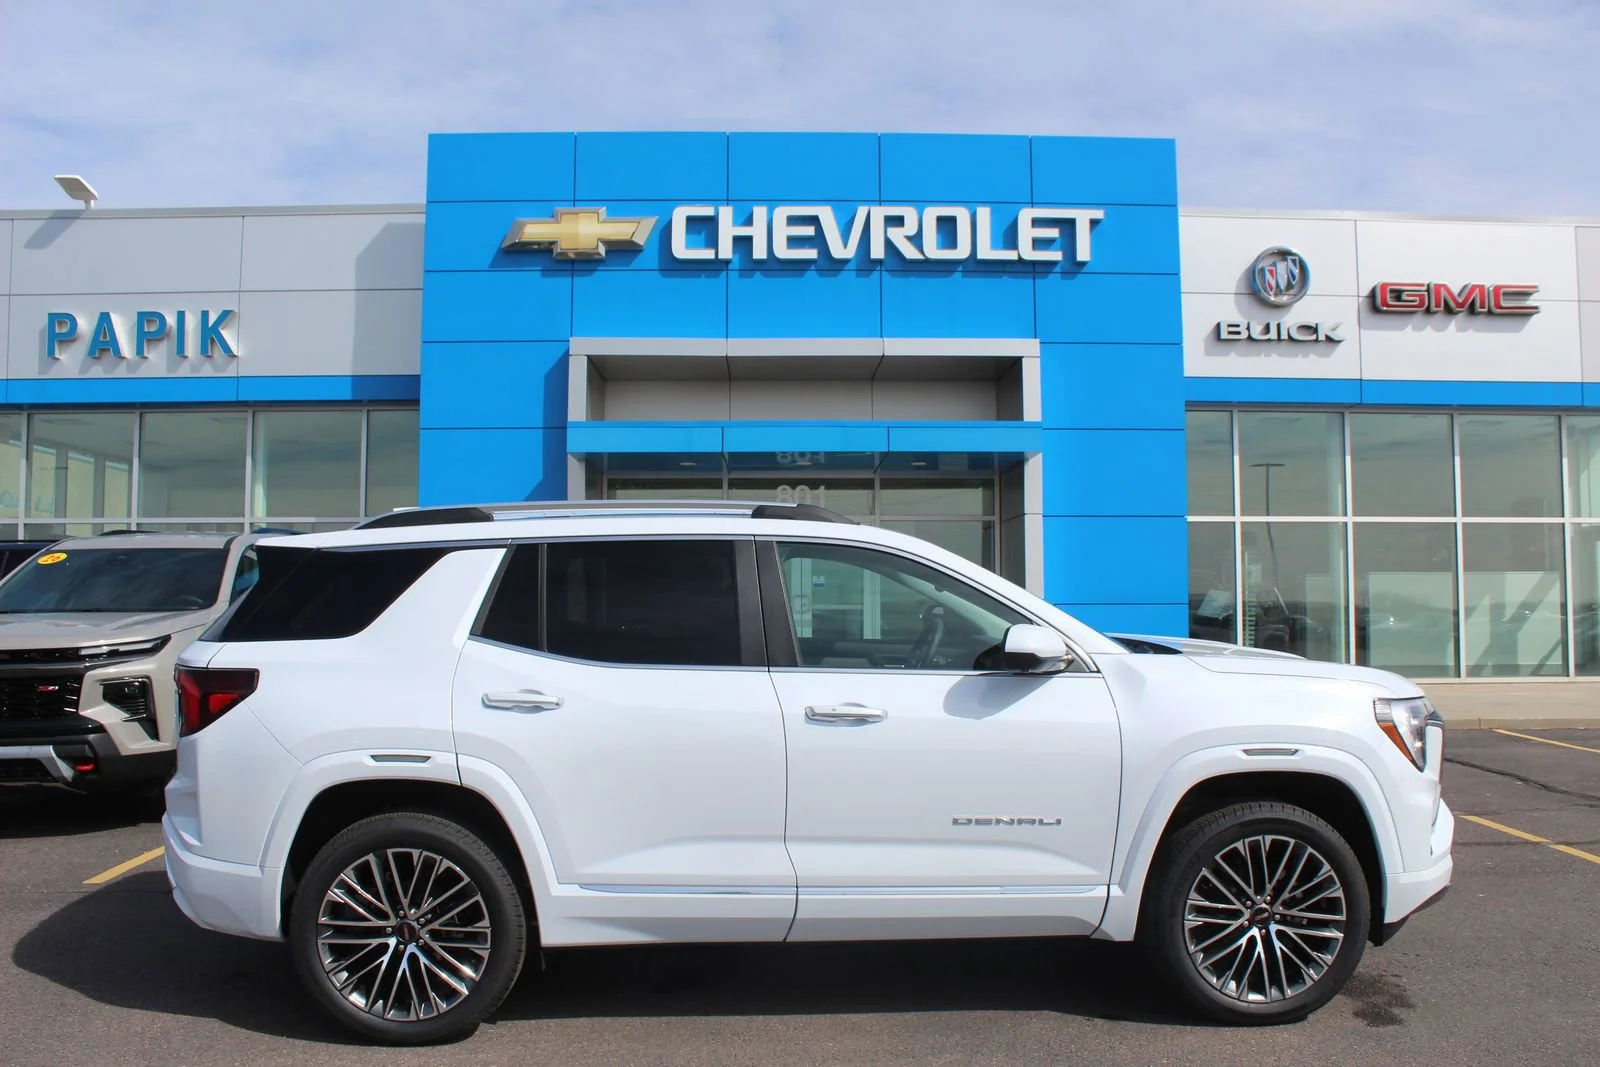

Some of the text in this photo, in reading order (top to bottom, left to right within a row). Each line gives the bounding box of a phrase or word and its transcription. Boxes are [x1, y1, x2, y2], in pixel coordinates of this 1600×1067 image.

[670, 205, 1105, 262] CHEVROLET
[1373, 281, 1541, 316] GMC
[46, 310, 239, 360] PAPIK
[1217, 320, 1345, 343] BUICK
[952, 815, 1062, 826] DENALI
